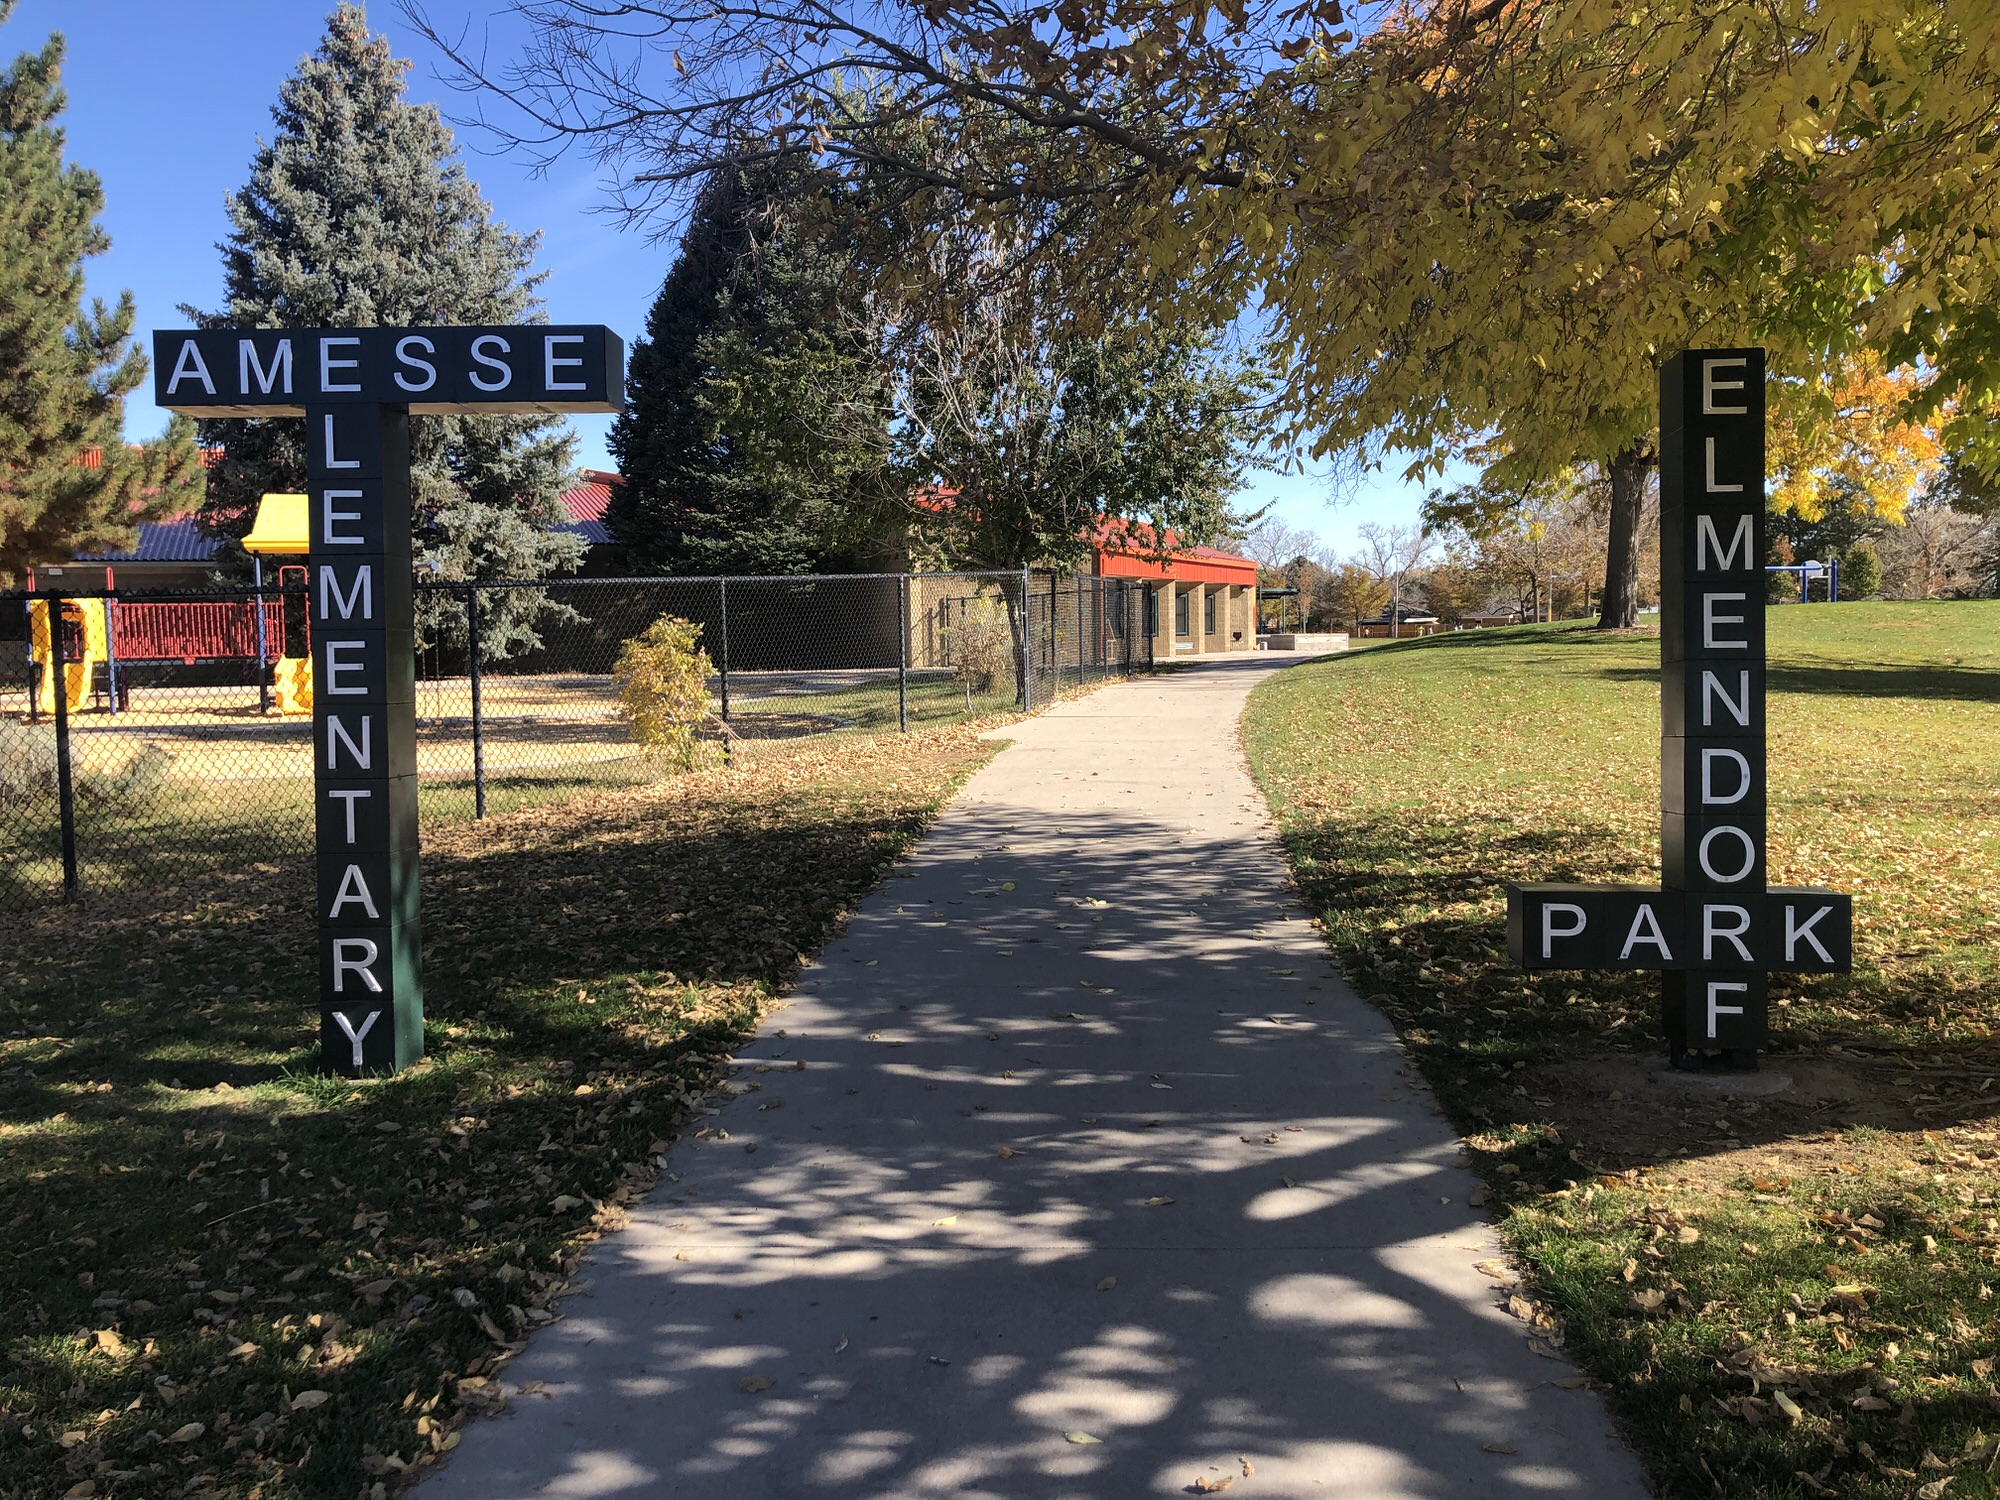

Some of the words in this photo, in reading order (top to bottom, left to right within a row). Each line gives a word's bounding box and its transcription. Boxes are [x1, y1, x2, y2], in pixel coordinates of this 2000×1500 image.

[166, 334, 587, 395] AMESSE
[1696, 357, 1755, 1039] ELMENDORF
[1542, 902, 1836, 964] PARK
